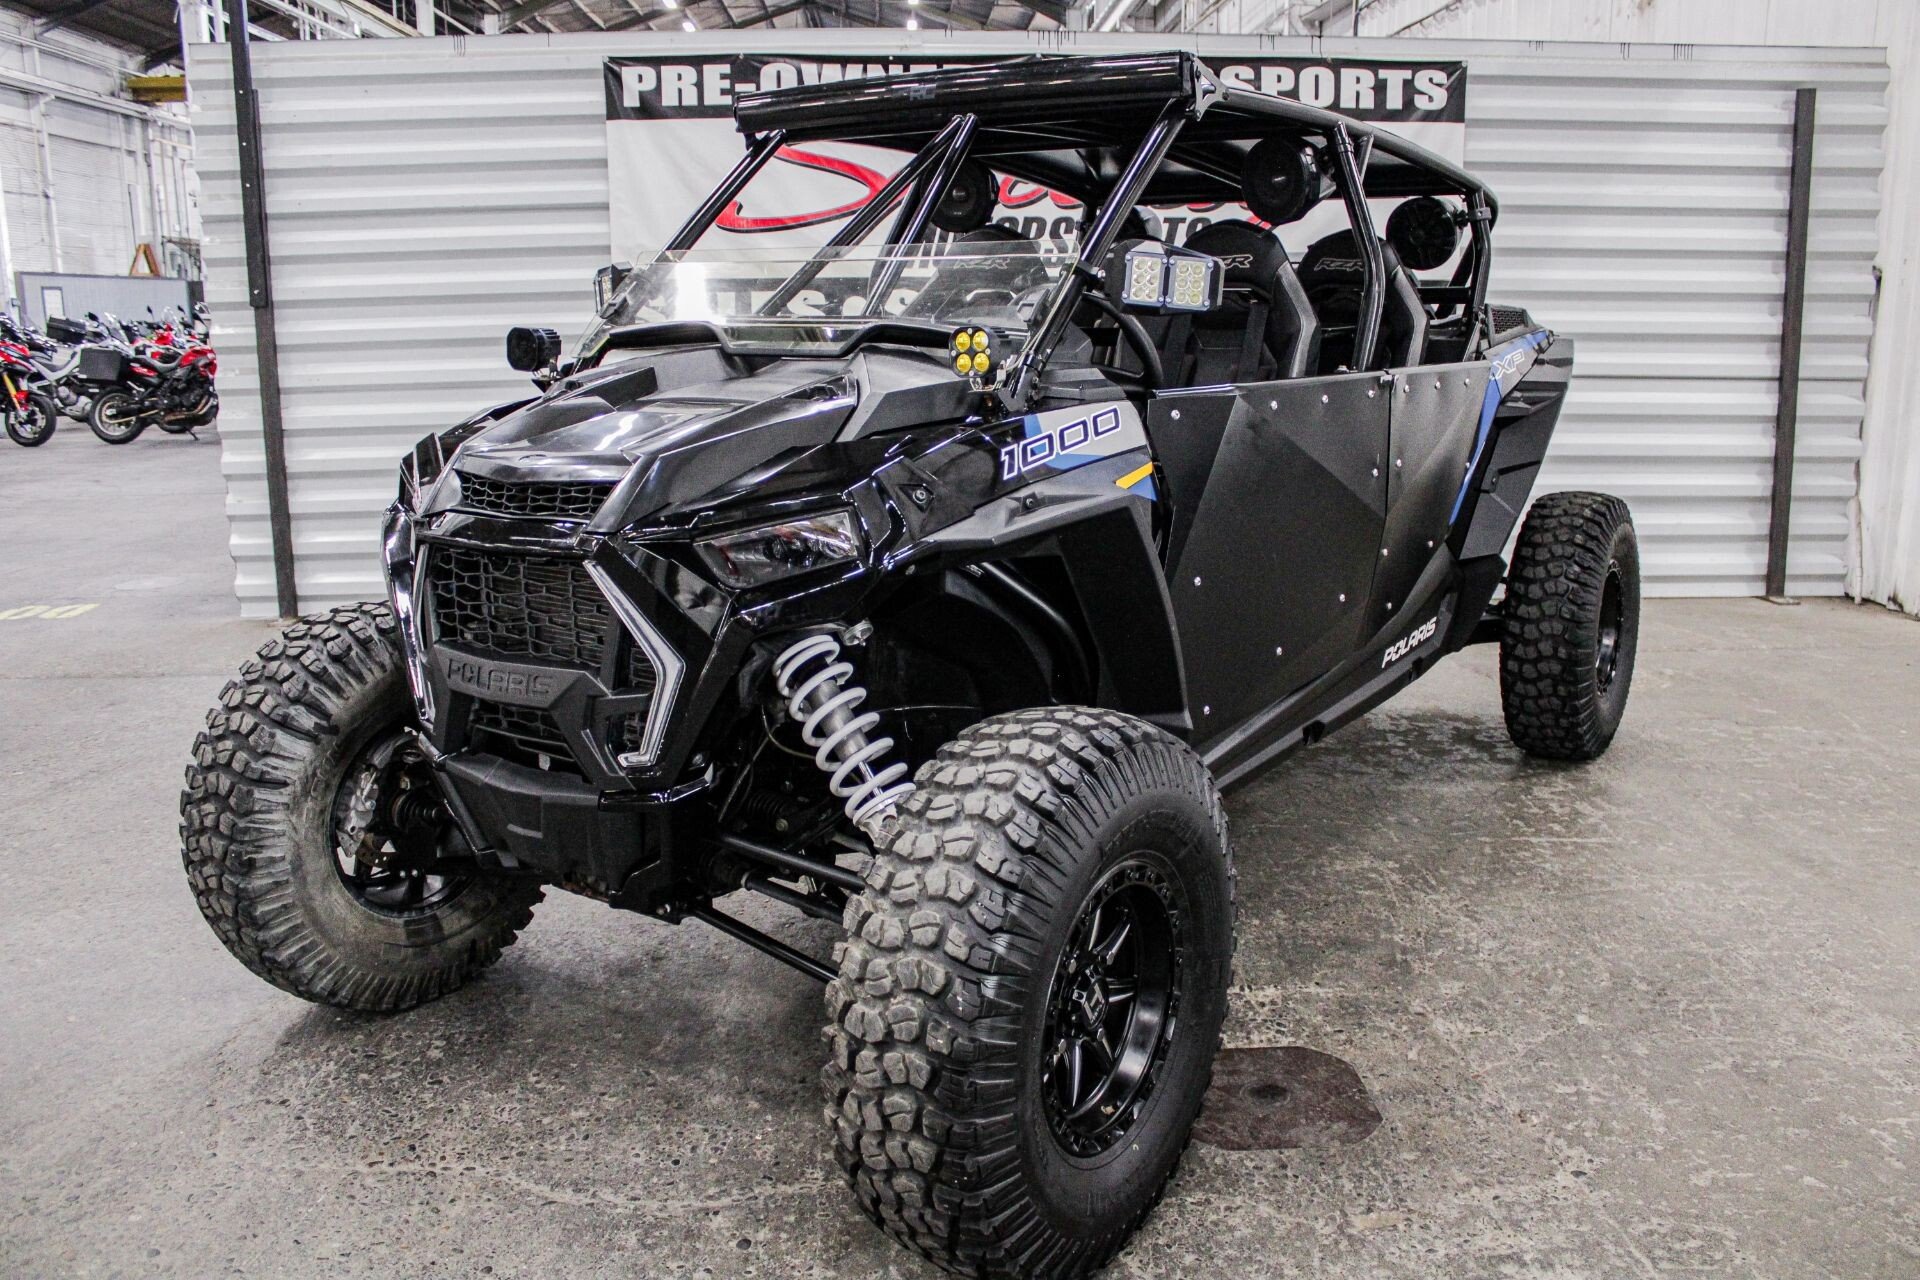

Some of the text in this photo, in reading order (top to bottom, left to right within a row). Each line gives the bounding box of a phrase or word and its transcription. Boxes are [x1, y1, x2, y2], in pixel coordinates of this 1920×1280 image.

[1490, 348, 1525, 380] XP
[1001, 405, 1122, 481] 1000
[1381, 616, 1438, 669] POLARIS
[447, 658, 555, 697] POLARIS
